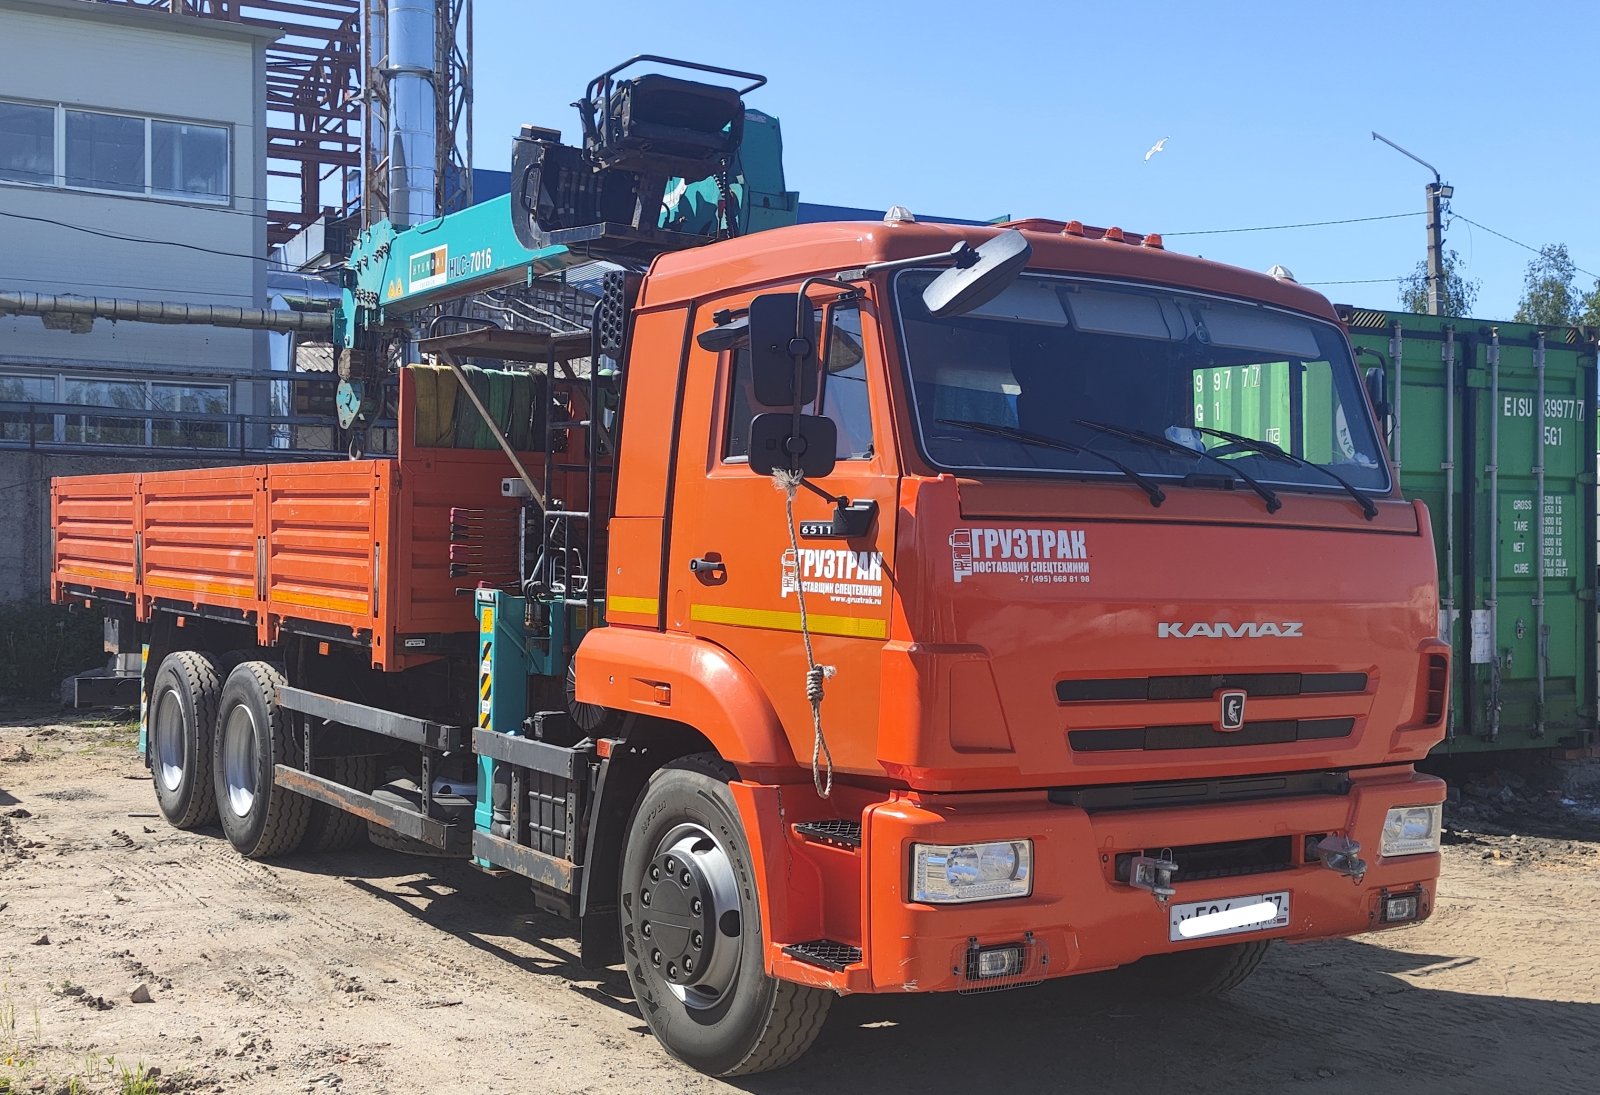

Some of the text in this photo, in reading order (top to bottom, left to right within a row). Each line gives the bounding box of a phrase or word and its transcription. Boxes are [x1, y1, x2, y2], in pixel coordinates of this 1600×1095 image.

[449, 247, 492, 280] HLC-7016
[1504, 396, 1533, 417] EISU
[1544, 426, 1562, 446] 5G1
[1513, 500, 1532, 510] GROSS
[1513, 521, 1528, 531] TARE
[971, 528, 1087, 559] ГРУЗТРАК
[1513, 542, 1525, 552] NET
[797, 549, 883, 581] ГРУЗТРАК
[973, 561, 1090, 574] ПОСТАВЩИК СПЕЦТЕХНИКИ
[1514, 563, 1529, 573] CUBE
[1020, 575, 1090, 584] +7 (495) 668 81 98
[834, 583, 882, 597] СПЕЦТЕХНИКИ
[830, 595, 882, 605] www.gruztrak.ru
[1158, 622, 1303, 637] KAMAZ
